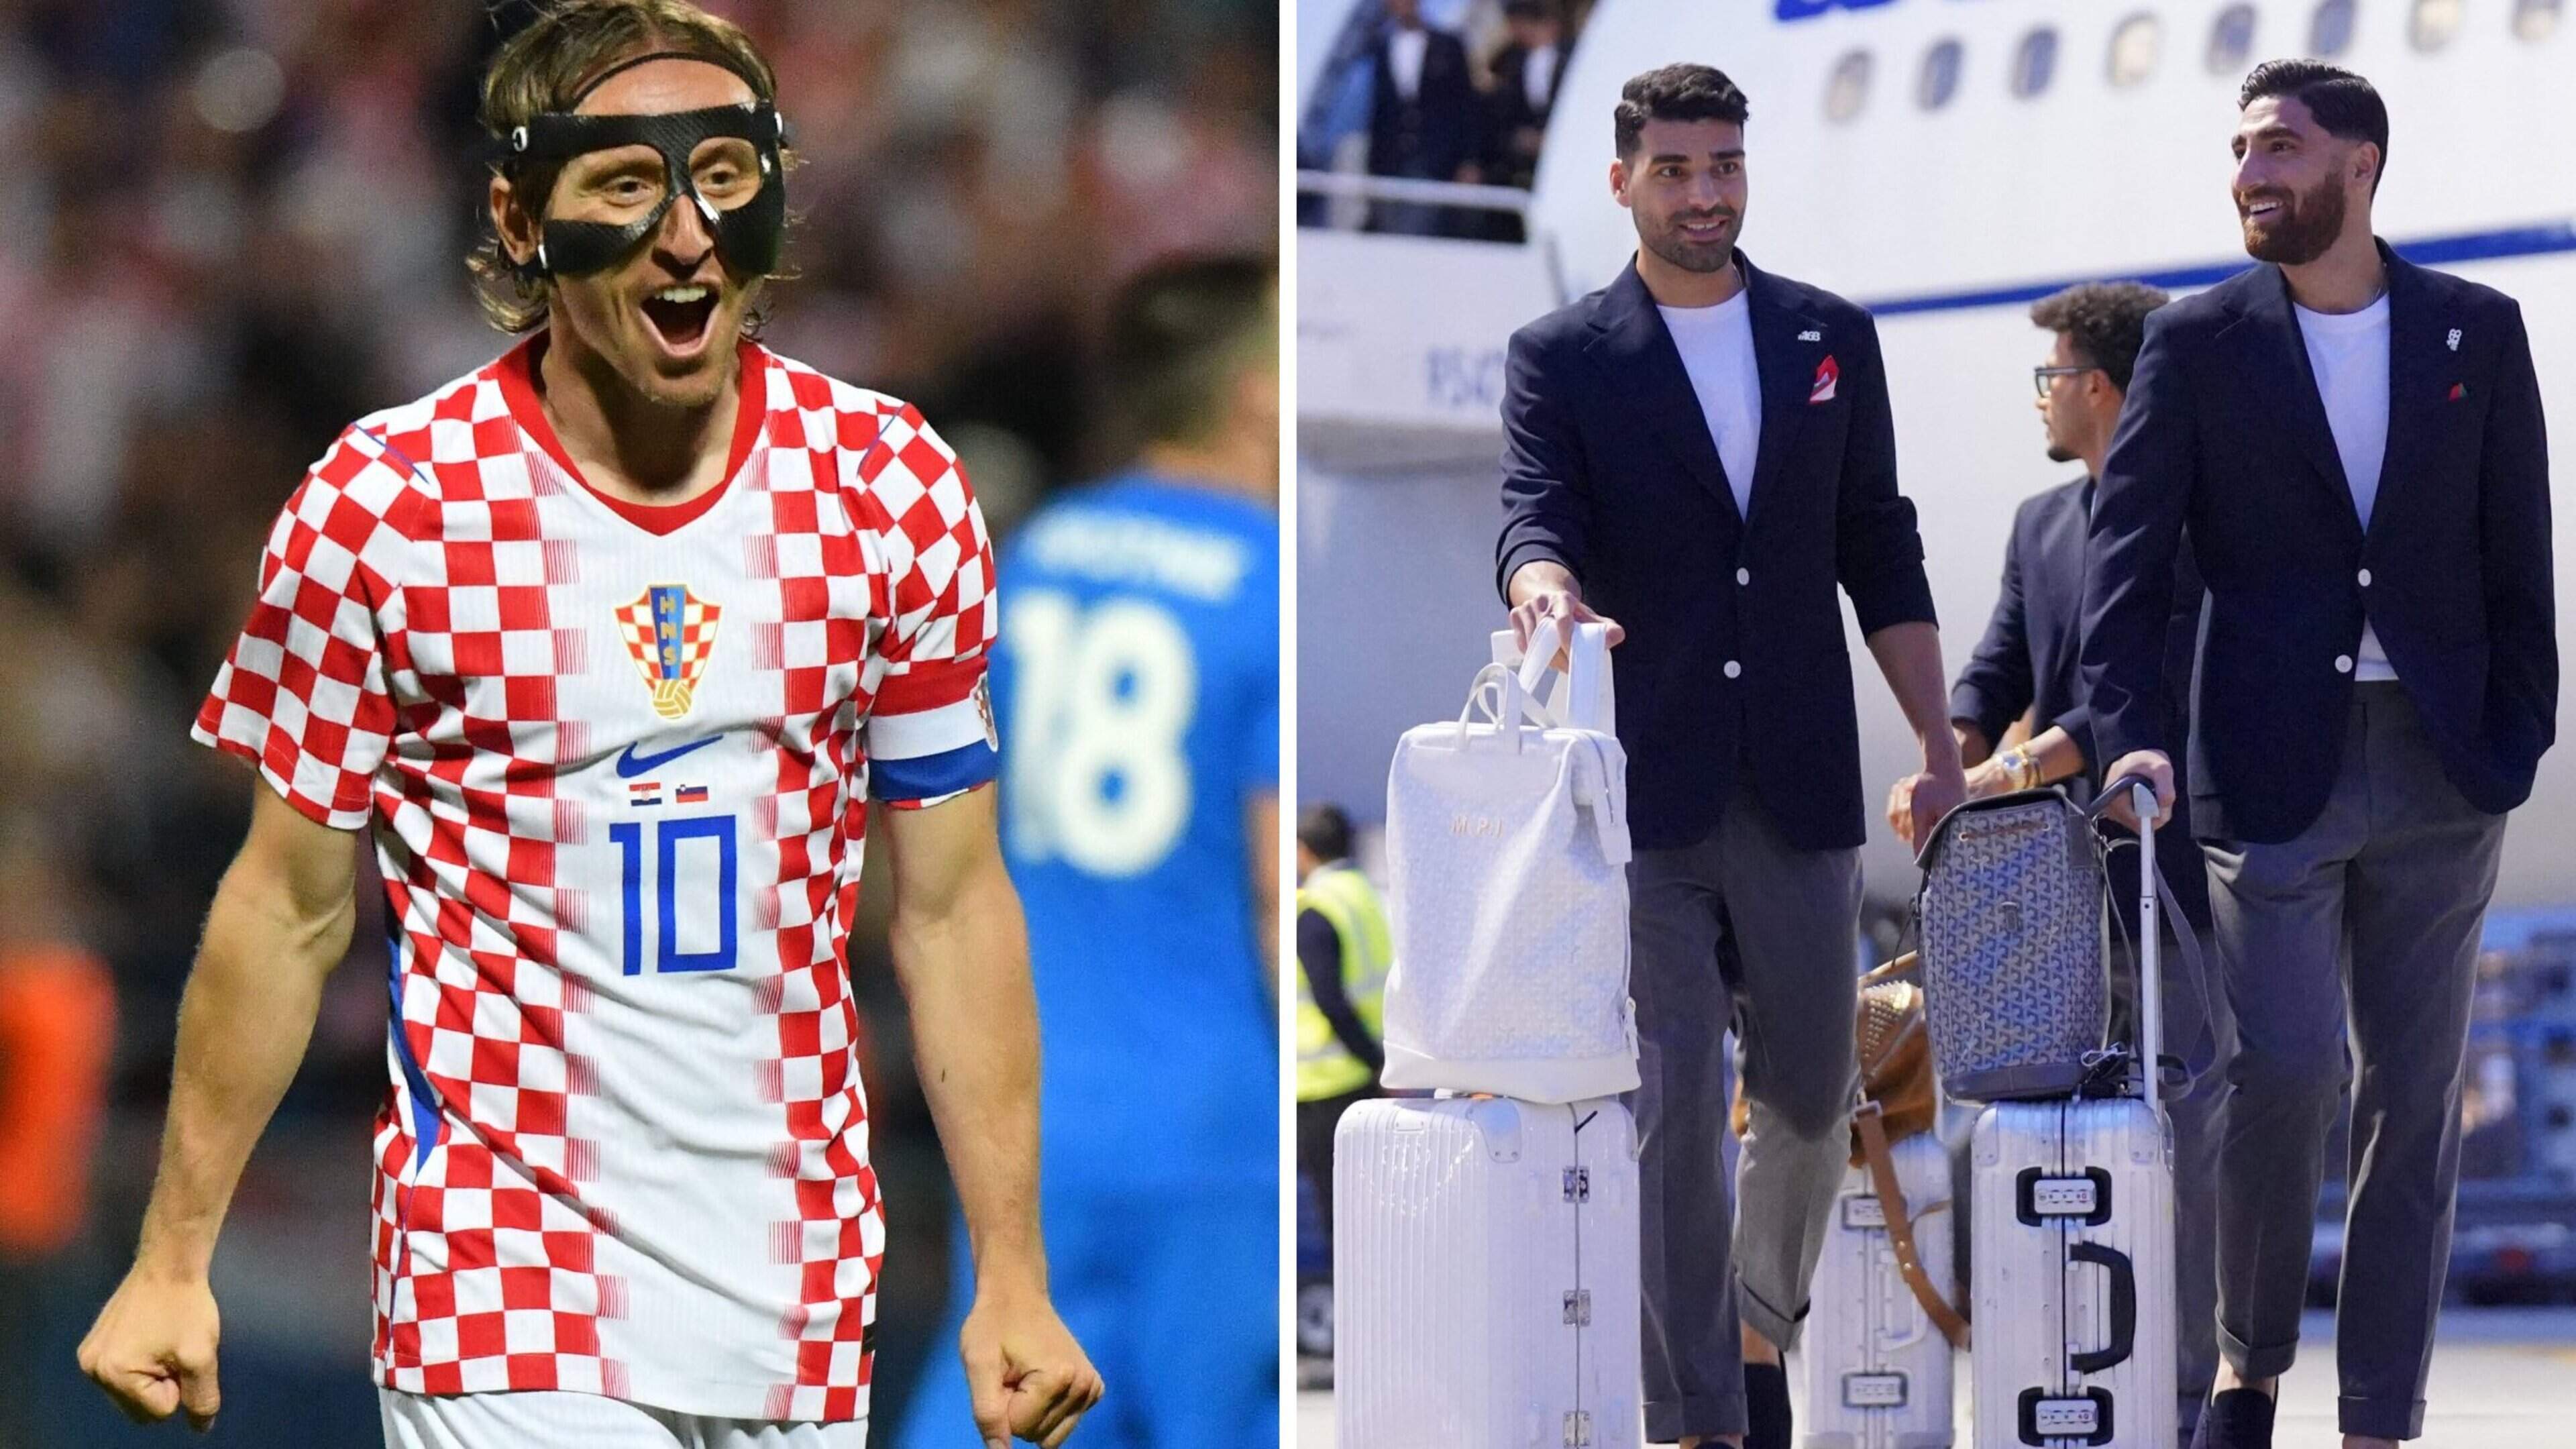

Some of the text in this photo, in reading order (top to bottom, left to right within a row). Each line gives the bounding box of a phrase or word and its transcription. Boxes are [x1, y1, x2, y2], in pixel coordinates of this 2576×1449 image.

[659, 596, 676, 665] HNS
[1009, 589, 1197, 875] 18
[610, 815, 737, 975] 10
